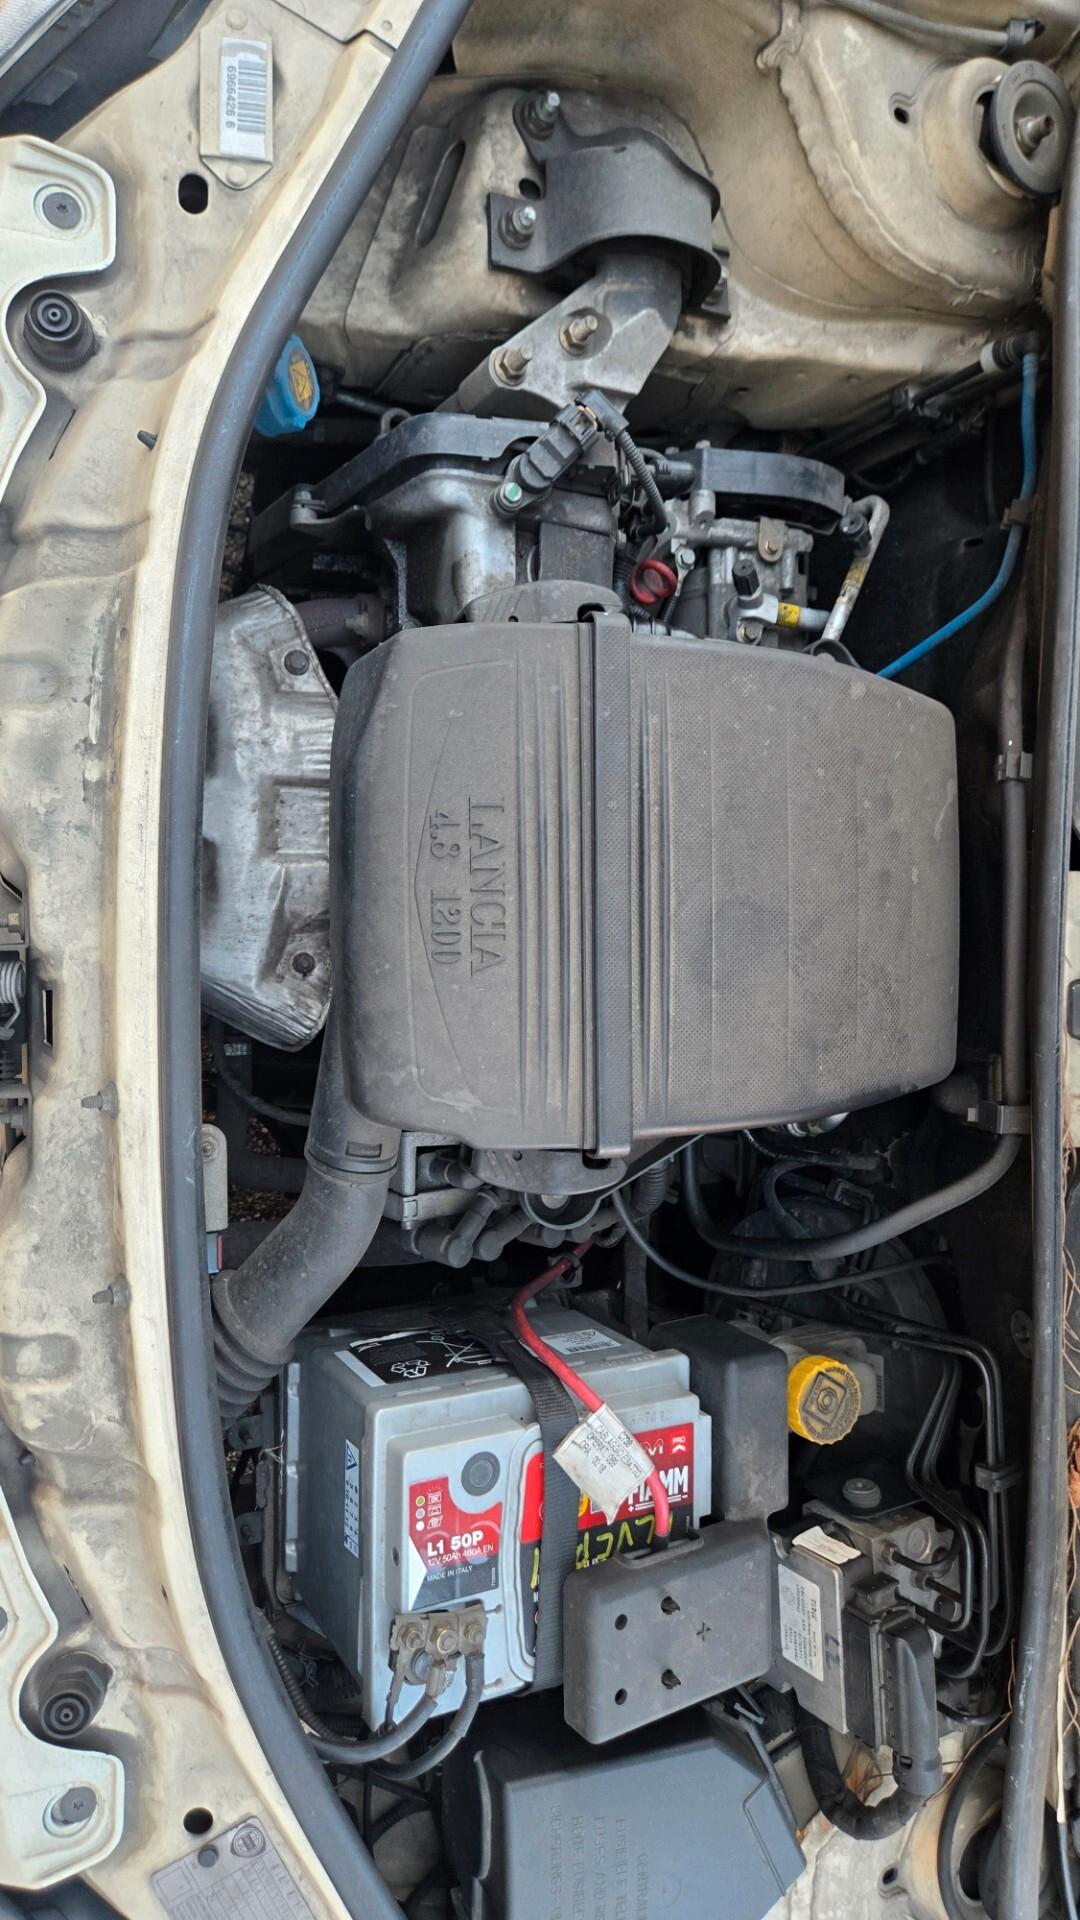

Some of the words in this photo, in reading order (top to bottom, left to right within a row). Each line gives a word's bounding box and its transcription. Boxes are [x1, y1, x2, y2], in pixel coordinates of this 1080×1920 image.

[468, 796, 507, 977] LANCIA
[430, 888, 462, 965] 1200
[620, 1454, 642, 1479] ESATTO
[427, 1539, 444, 1557] L1
[450, 1530, 484, 1550] 50P
[428, 1556, 441, 1566] 12V
[442, 1551, 461, 1563] 50Ah
[482, 1543, 494, 1553] EN
[427, 1571, 445, 1582] MADE
[447, 1569, 454, 1577] IN
[455, 1565, 473, 1575] ITALY
